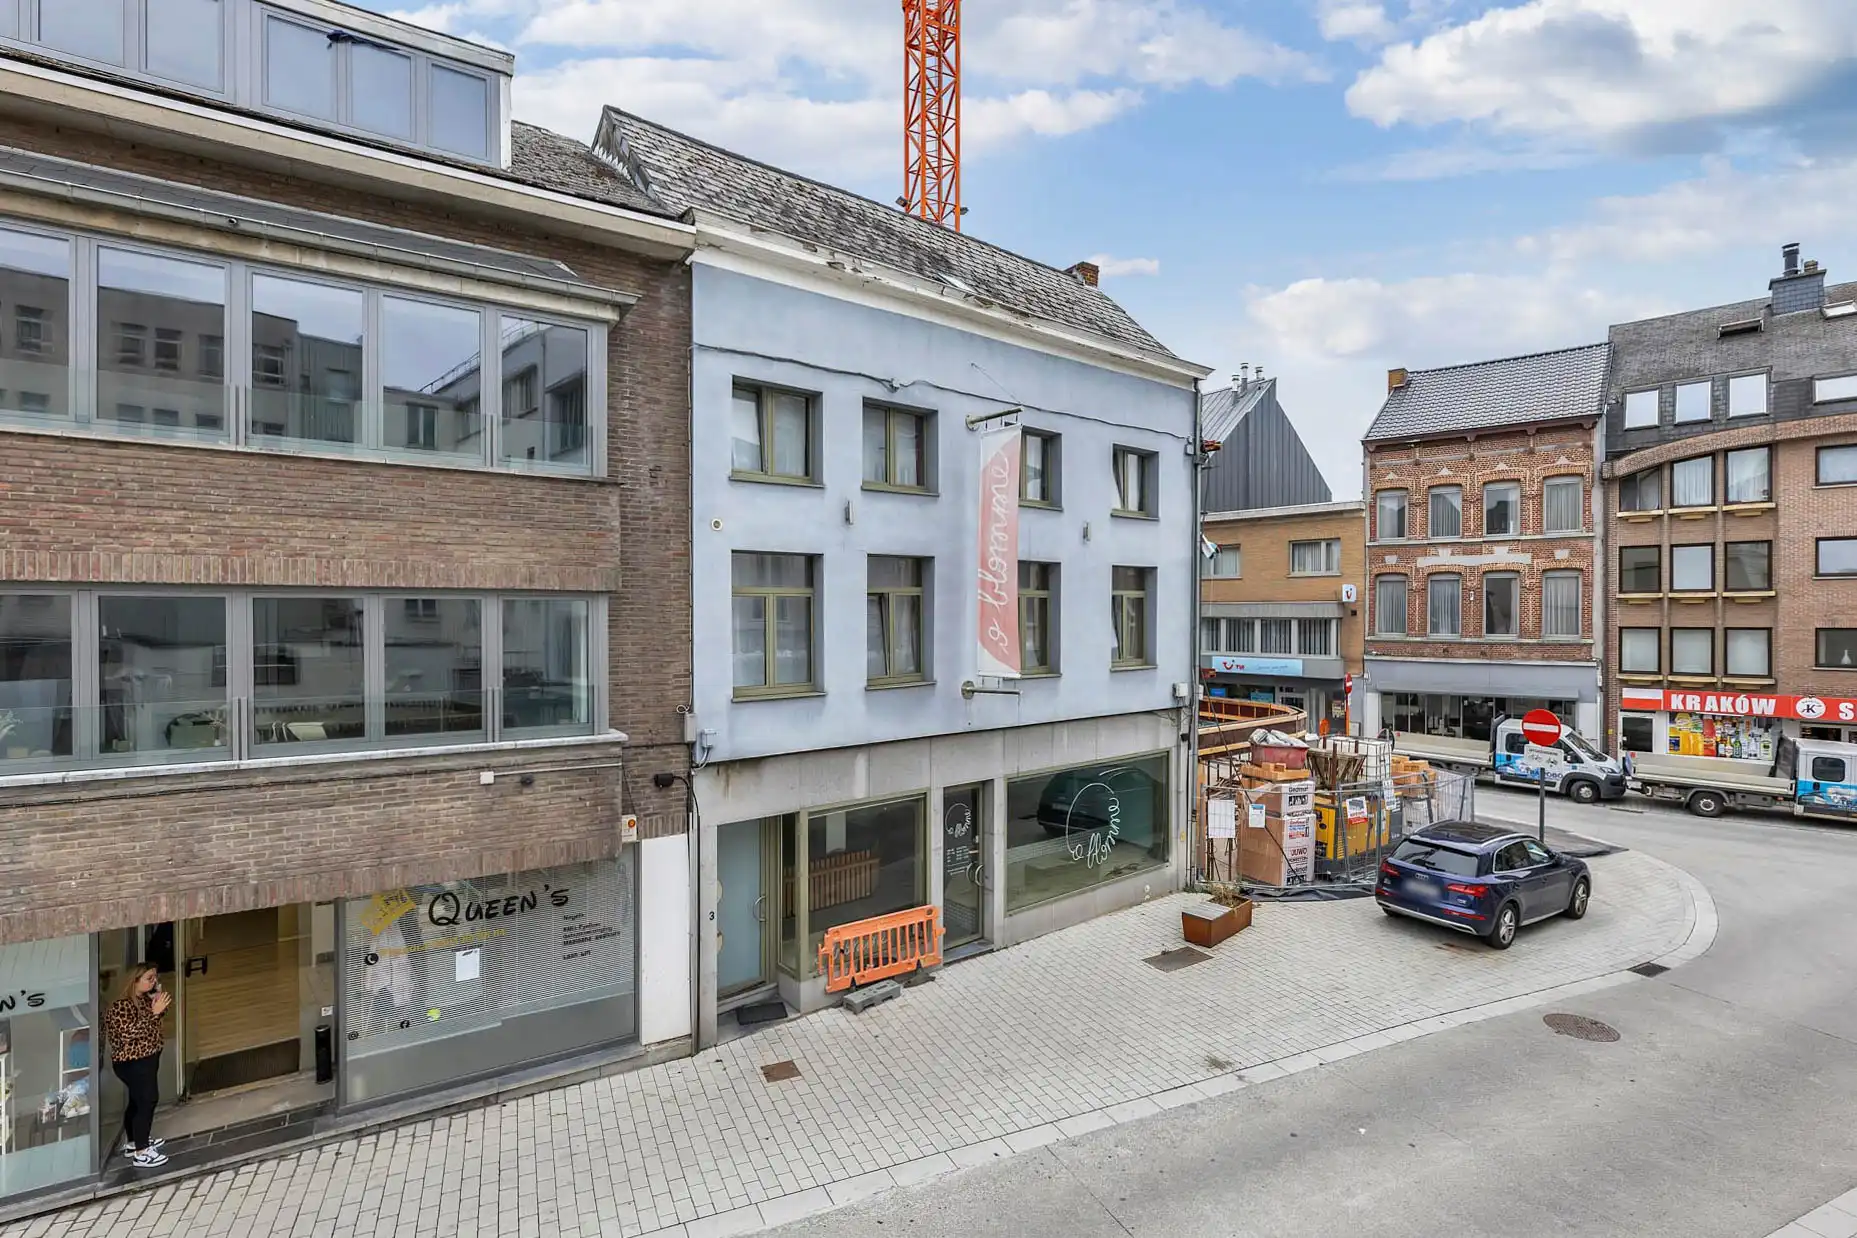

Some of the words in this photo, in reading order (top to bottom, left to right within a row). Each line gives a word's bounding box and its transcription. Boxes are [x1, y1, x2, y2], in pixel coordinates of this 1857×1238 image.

[1671, 694, 1777, 716] KRAKÓW
[428, 884, 569, 926] QUEEN'S
[709, 911, 715, 921] 3
